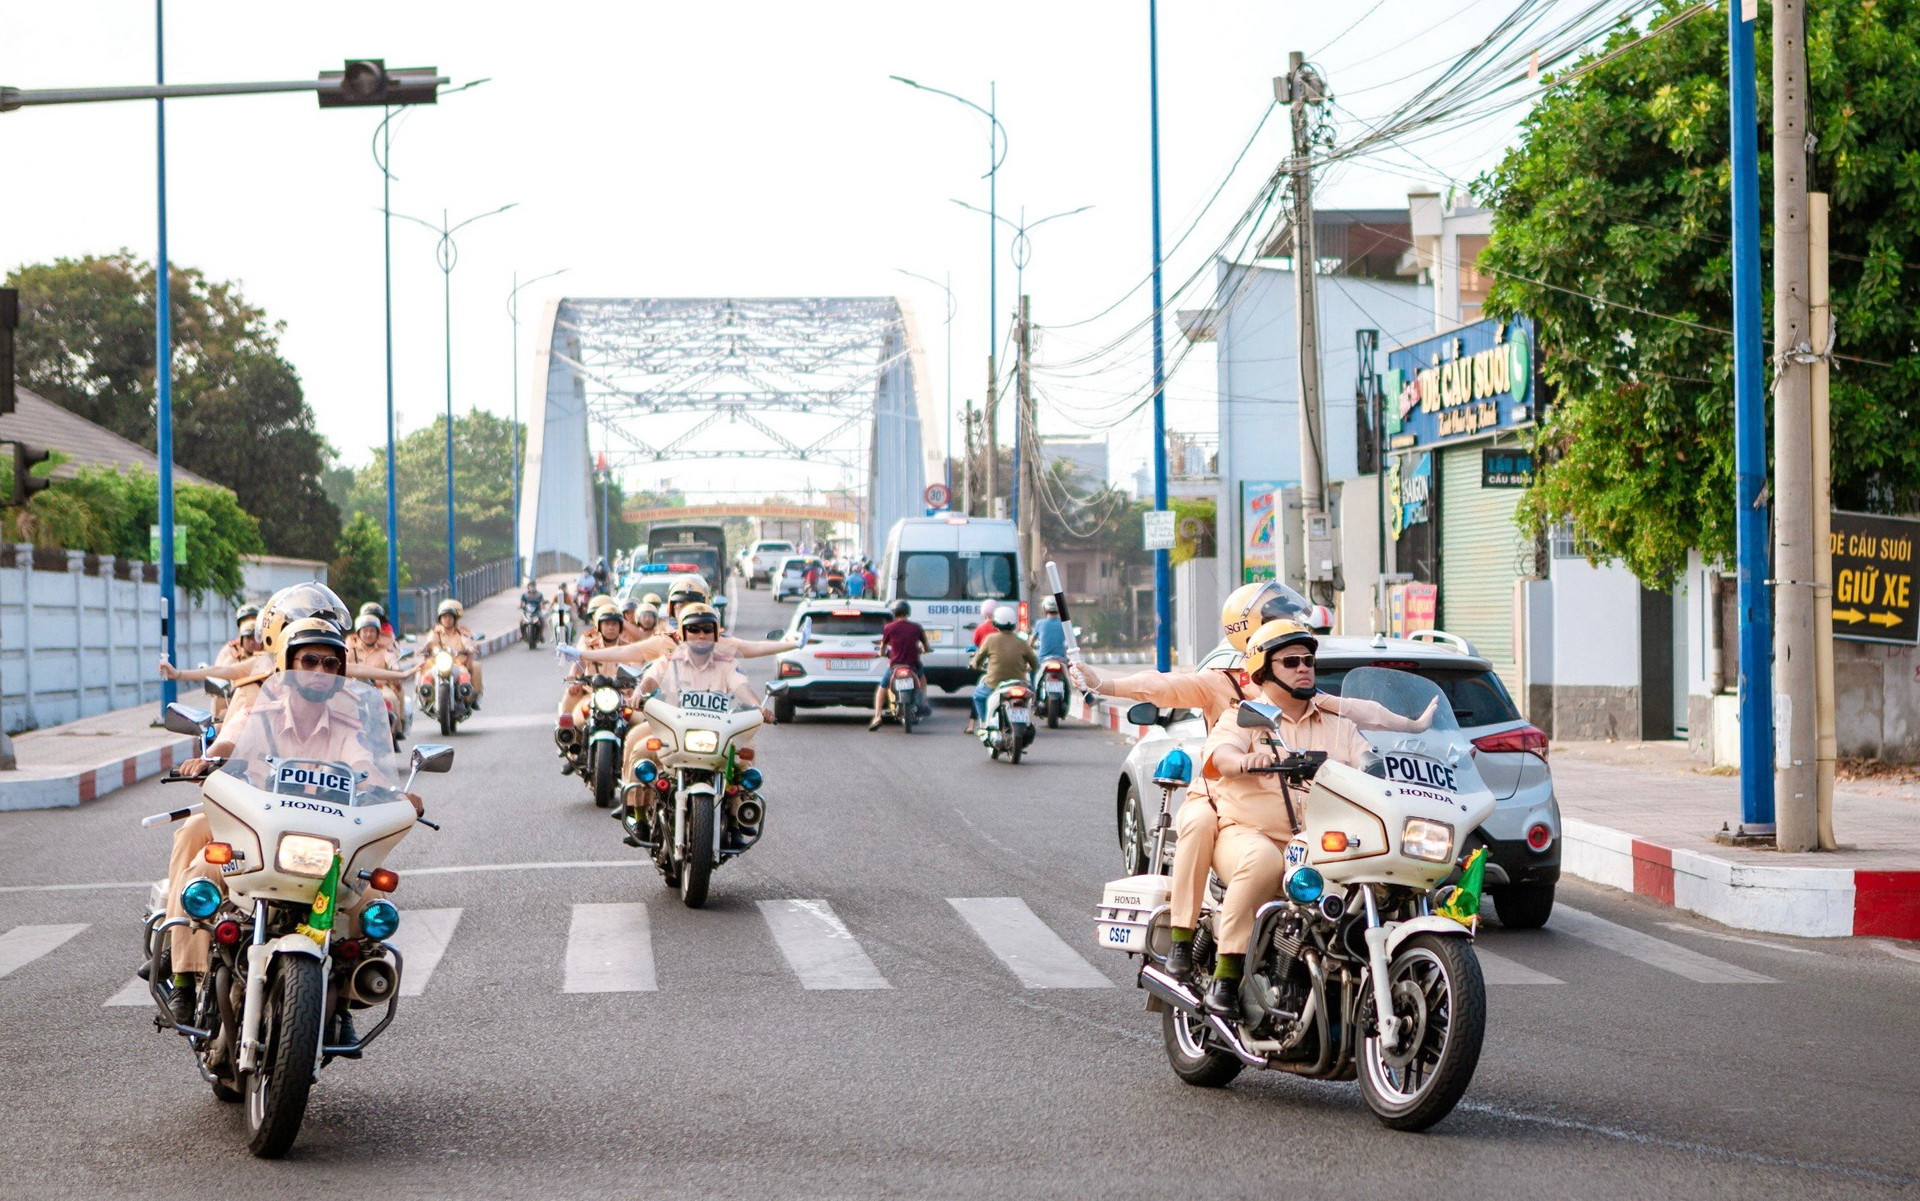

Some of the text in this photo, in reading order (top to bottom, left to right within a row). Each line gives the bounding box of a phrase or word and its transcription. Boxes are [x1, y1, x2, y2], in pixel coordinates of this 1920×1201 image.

[1838, 566, 1911, 609] GIỮ XE
[682, 693, 729, 711] POLICE
[685, 712, 722, 720] HONDA
[281, 768, 351, 792] POLICE
[1385, 756, 1458, 791] POLICE
[1398, 788, 1455, 805] HONDA
[280, 800, 345, 818] HONDA
[1114, 895, 1141, 905] HONDA
[1109, 926, 1131, 943] CSGT
